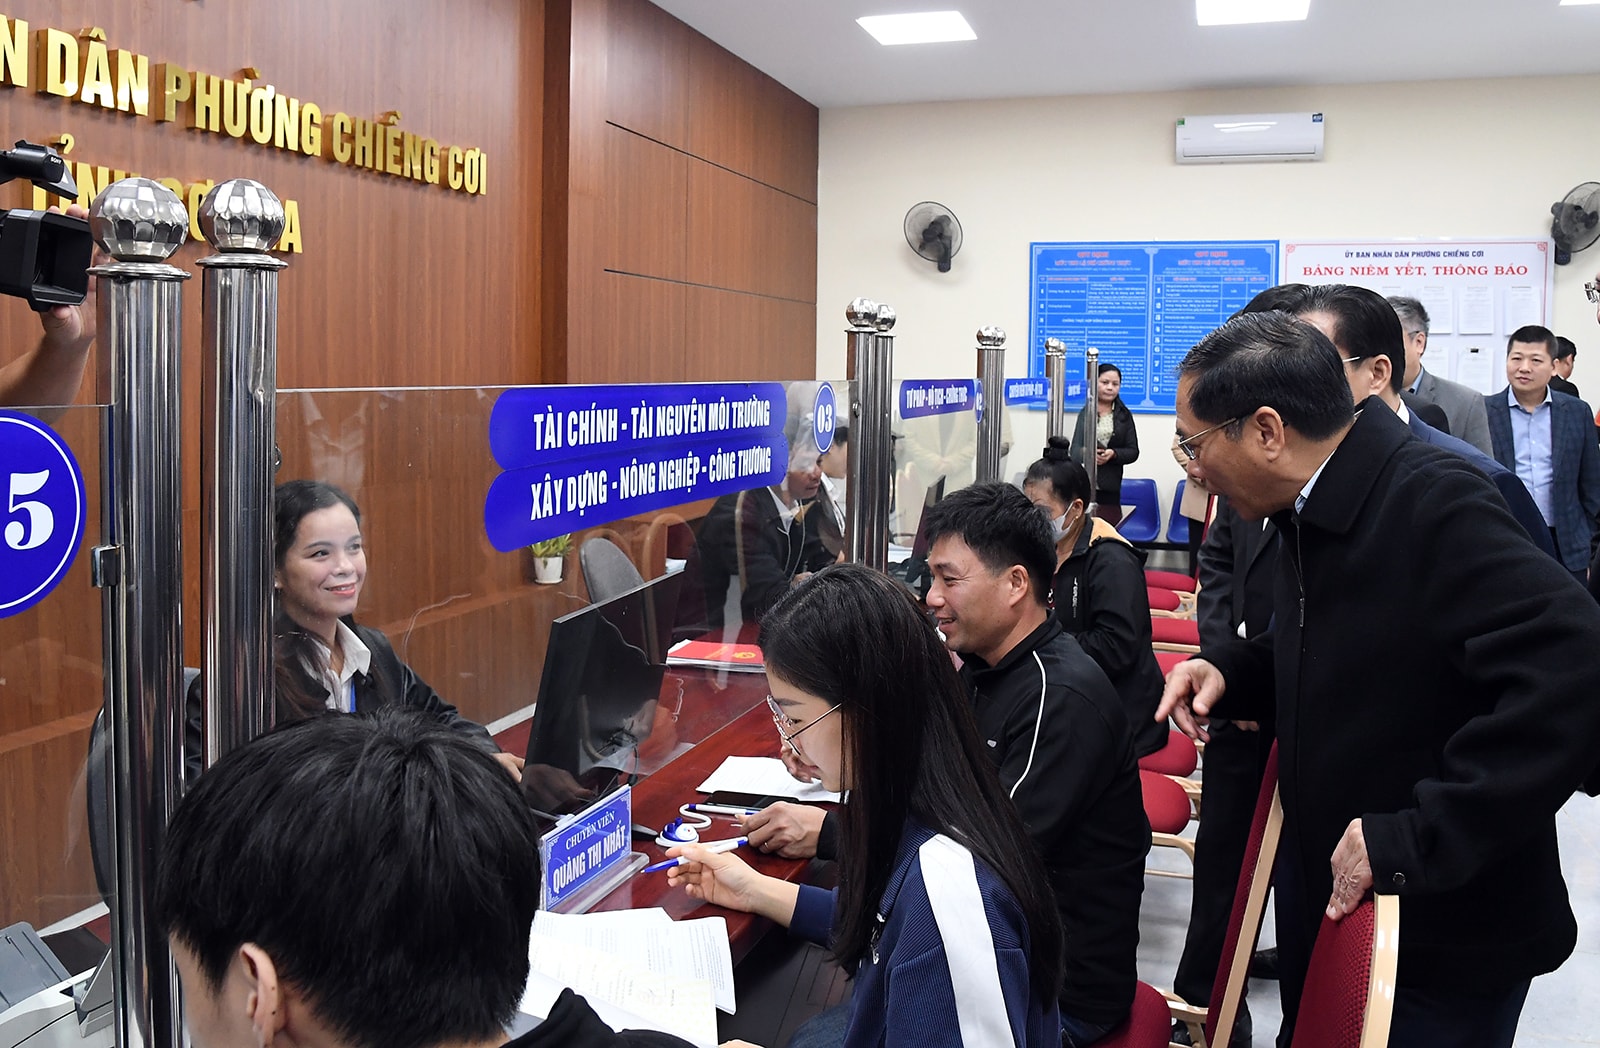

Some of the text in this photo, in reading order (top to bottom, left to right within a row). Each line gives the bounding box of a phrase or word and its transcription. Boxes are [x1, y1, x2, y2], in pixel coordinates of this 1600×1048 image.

[46, 27, 148, 116] DÂN
[164, 67, 321, 157] PHƯỜNG
[448, 145, 487, 195] CƠI
[1303, 264, 1344, 276] BẢNG
[1350, 264, 1389, 276] NIÊM
[1432, 263, 1488, 275] THÔNG
[1494, 263, 1528, 275] BÁO
[1373, 250, 1392, 258] NHÂN
[1395, 250, 1409, 258] DÂN
[533, 404, 563, 451] TÀI
[567, 402, 618, 447] CHÍNH
[631, 400, 653, 440] TÀI
[656, 397, 706, 437] NGUYÊN
[708, 396, 730, 431] MÔI
[732, 394, 770, 428] TRƯỜNG
[817, 404, 833, 433] 03
[4, 469, 54, 550] 5
[530, 473, 563, 521] XÂY
[567, 469, 607, 516] DỰNG
[619, 458, 656, 500] NÔNG
[658, 450, 700, 493] NGHIỆP
[709, 447, 736, 483] CÔNG
[738, 446, 771, 477] THƯƠNG
[553, 820, 626, 894] QUÀNG THỊ NHẤT
[566, 811, 615, 850] CHUYÊN VIÊN
